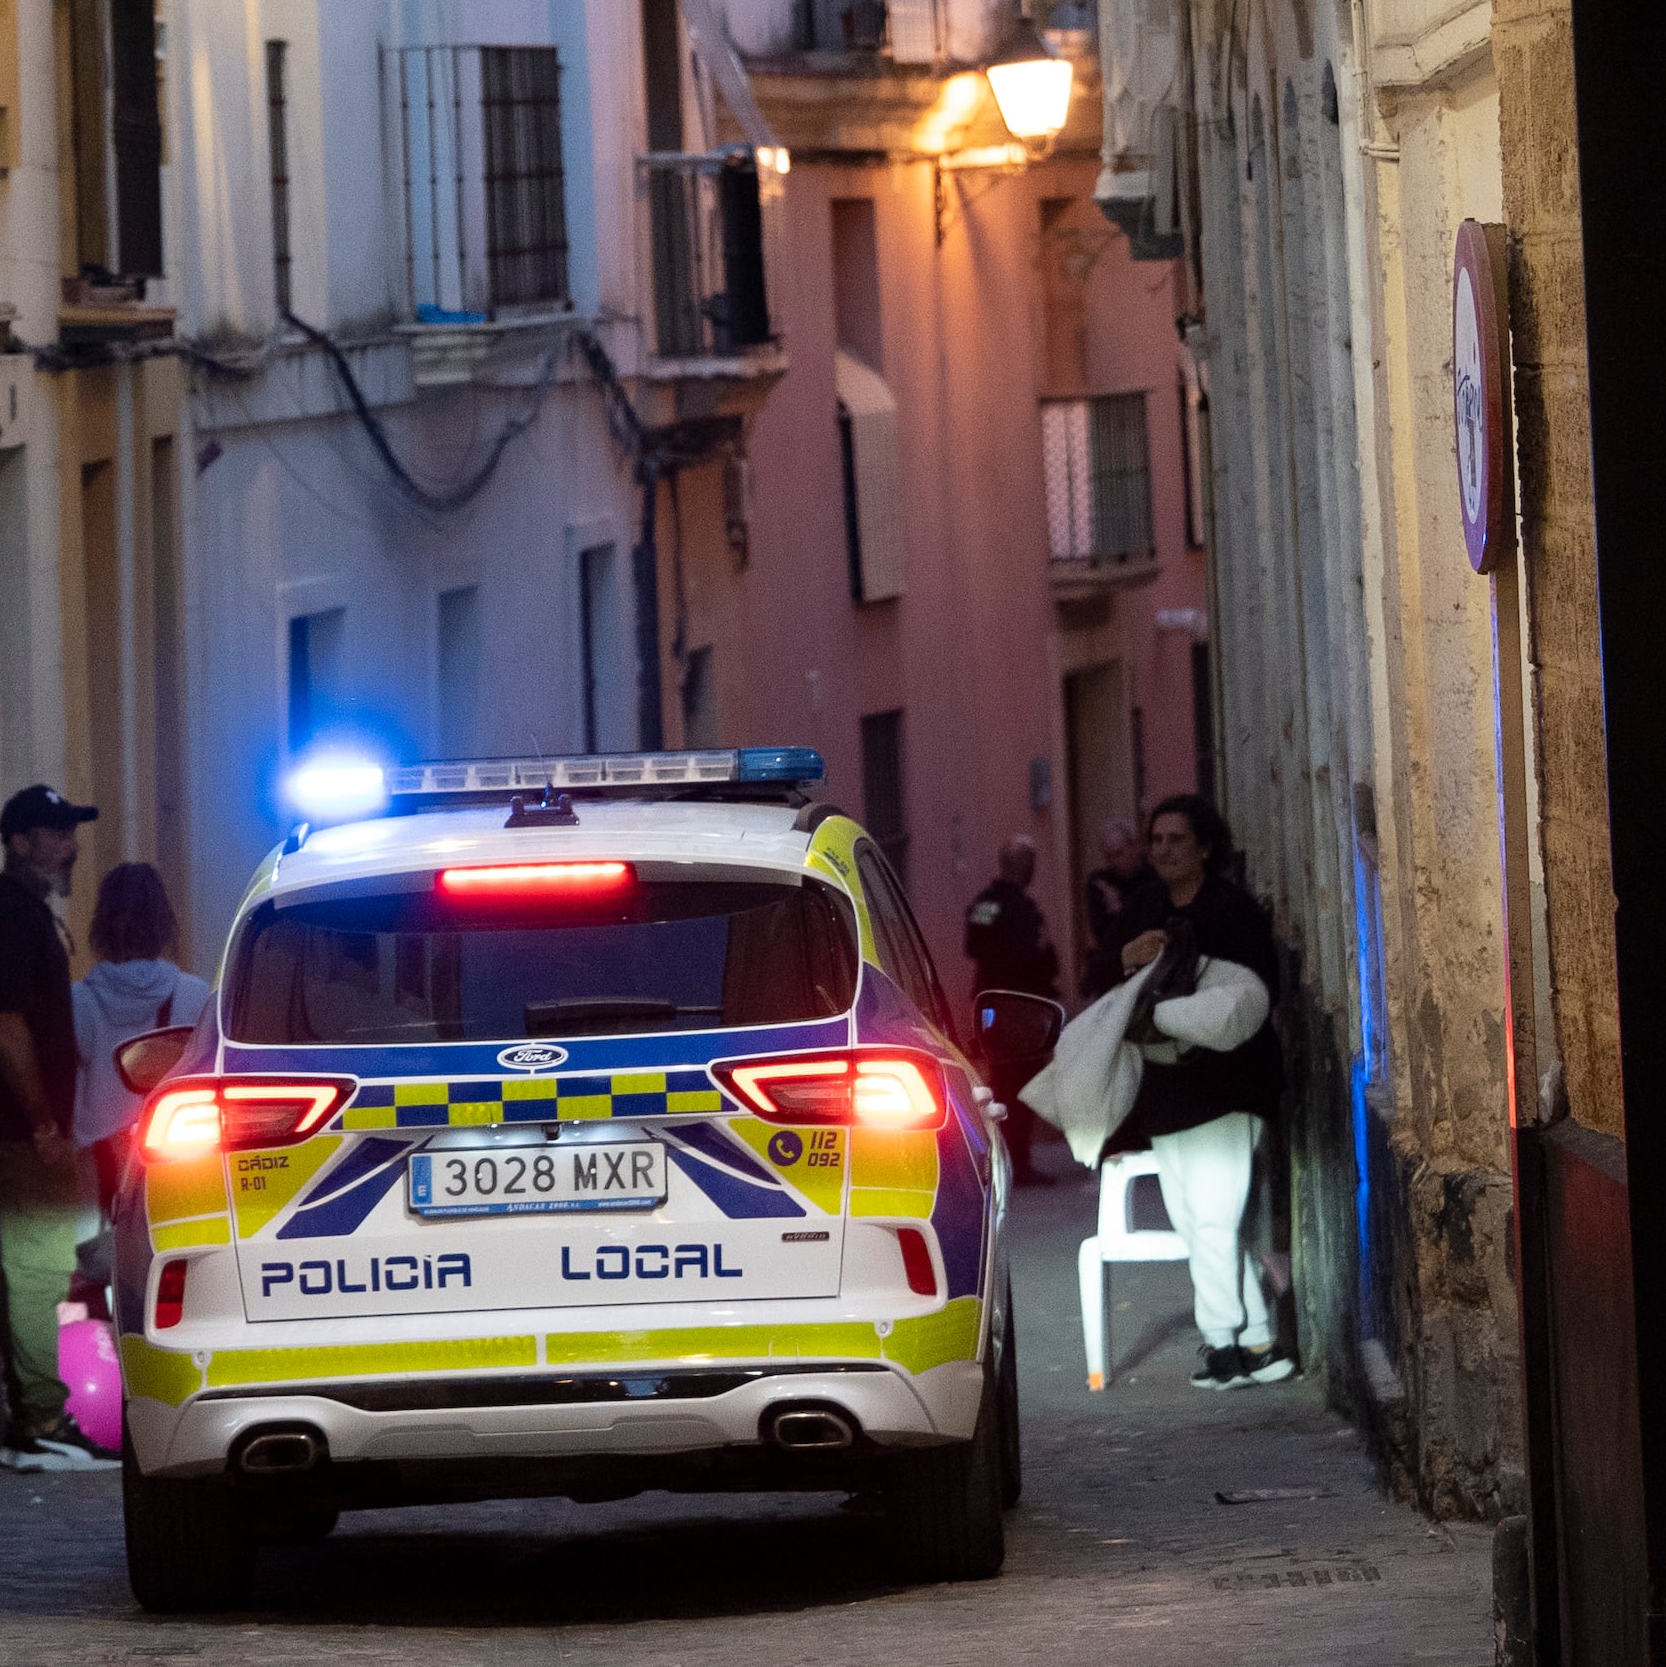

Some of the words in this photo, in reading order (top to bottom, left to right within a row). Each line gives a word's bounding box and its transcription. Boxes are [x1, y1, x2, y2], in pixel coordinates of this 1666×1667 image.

[513, 1048, 553, 1063] Ford
[810, 1130, 838, 1150] 112
[237, 1155, 290, 1172] CÁDIZ
[807, 1152, 841, 1167] 092
[444, 1154, 556, 1197] 3028
[573, 1150, 655, 1192] MXR
[240, 1176, 267, 1192] R-01
[417, 1184, 427, 1197] E
[560, 1242, 744, 1281] LOCAL
